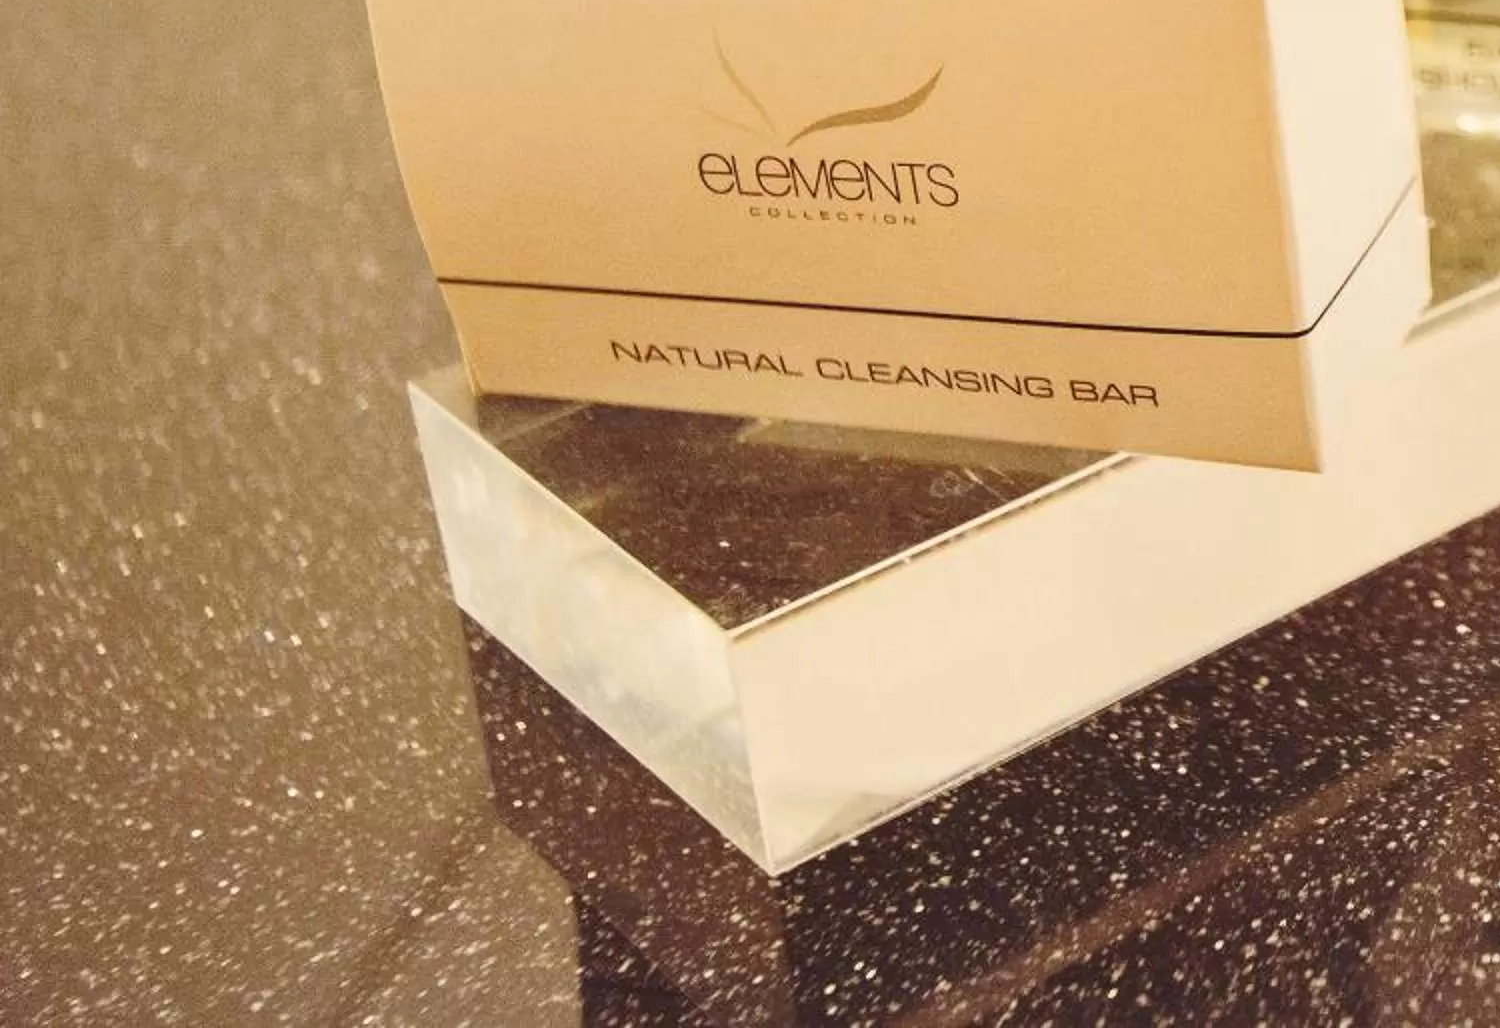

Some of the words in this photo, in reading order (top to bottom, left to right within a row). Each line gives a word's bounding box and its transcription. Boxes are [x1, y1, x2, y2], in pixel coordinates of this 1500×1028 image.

[748, 206, 917, 226] COLLECTION
[609, 339, 803, 377] NATURAL
[815, 357, 1054, 399] CLEANSING
[1069, 378, 1159, 408] BAR
